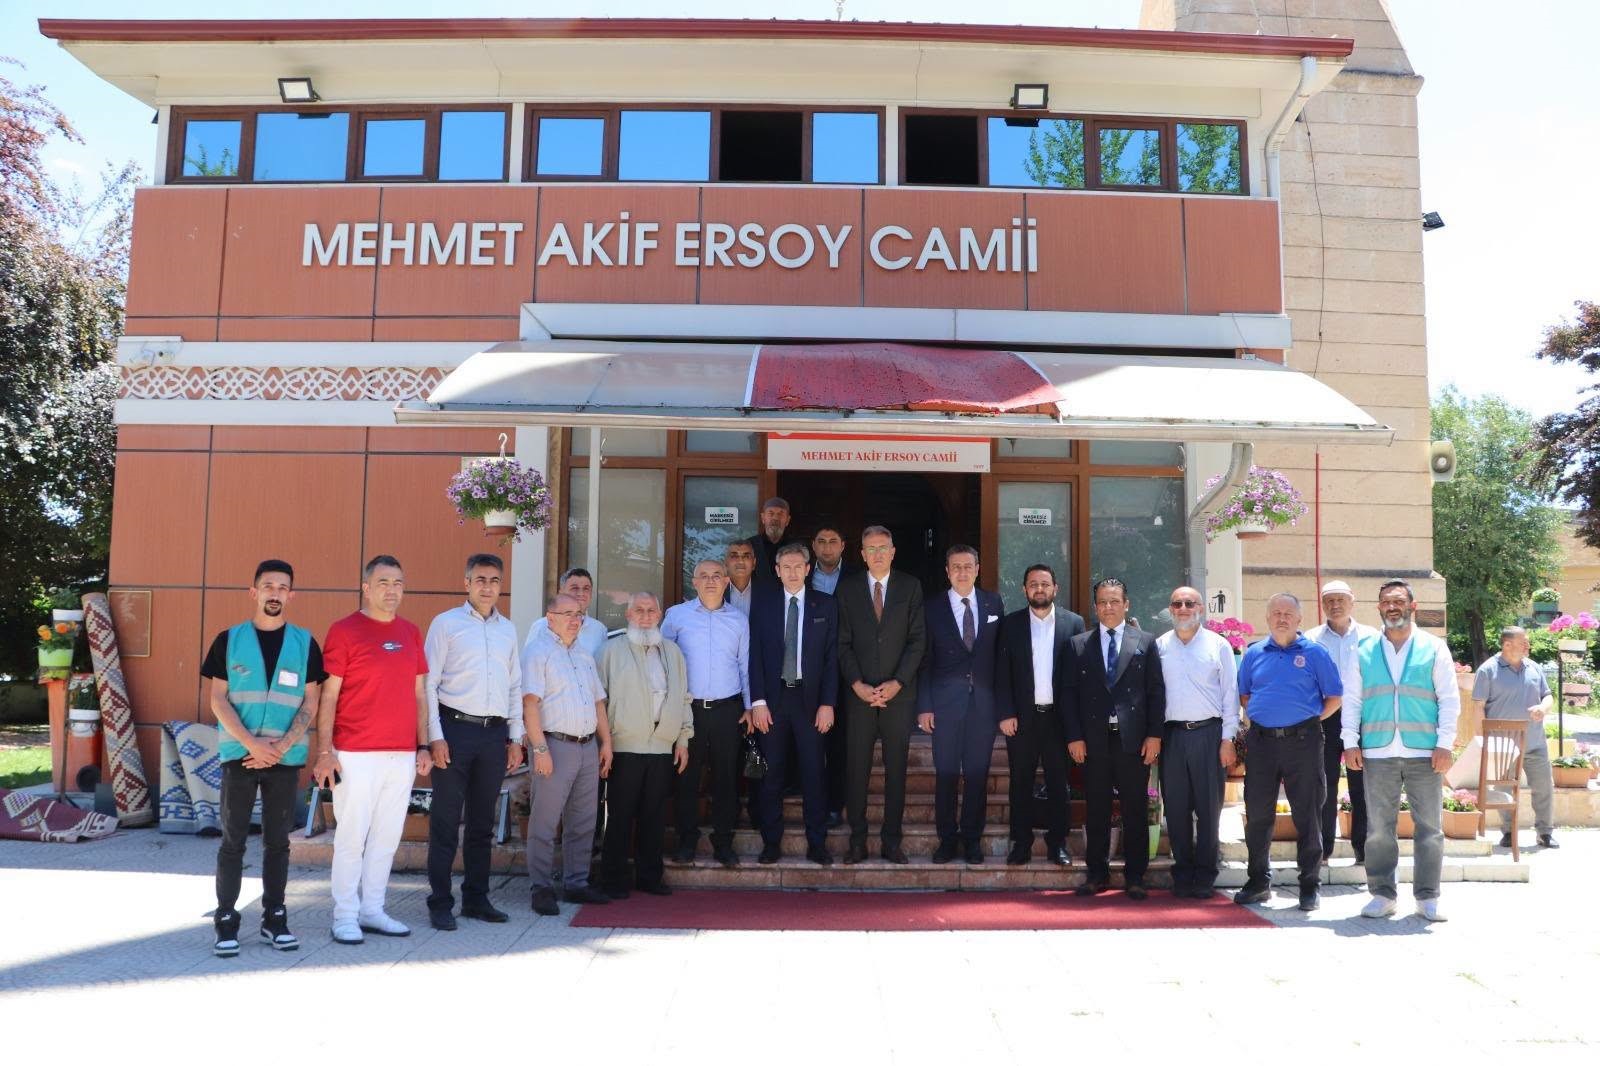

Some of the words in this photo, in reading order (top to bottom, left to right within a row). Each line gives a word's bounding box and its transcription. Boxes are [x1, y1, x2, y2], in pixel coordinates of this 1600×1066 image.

[302, 222, 524, 267] MEHMET
[537, 211, 660, 267] AKİF
[675, 222, 853, 269] ERSOY
[869, 217, 1039, 273] CAMİİ
[801, 451, 853, 461] MEHMET
[855, 450, 883, 461] AKİF
[884, 451, 920, 462] ERSOY
[922, 451, 958, 463] CAMİİ
